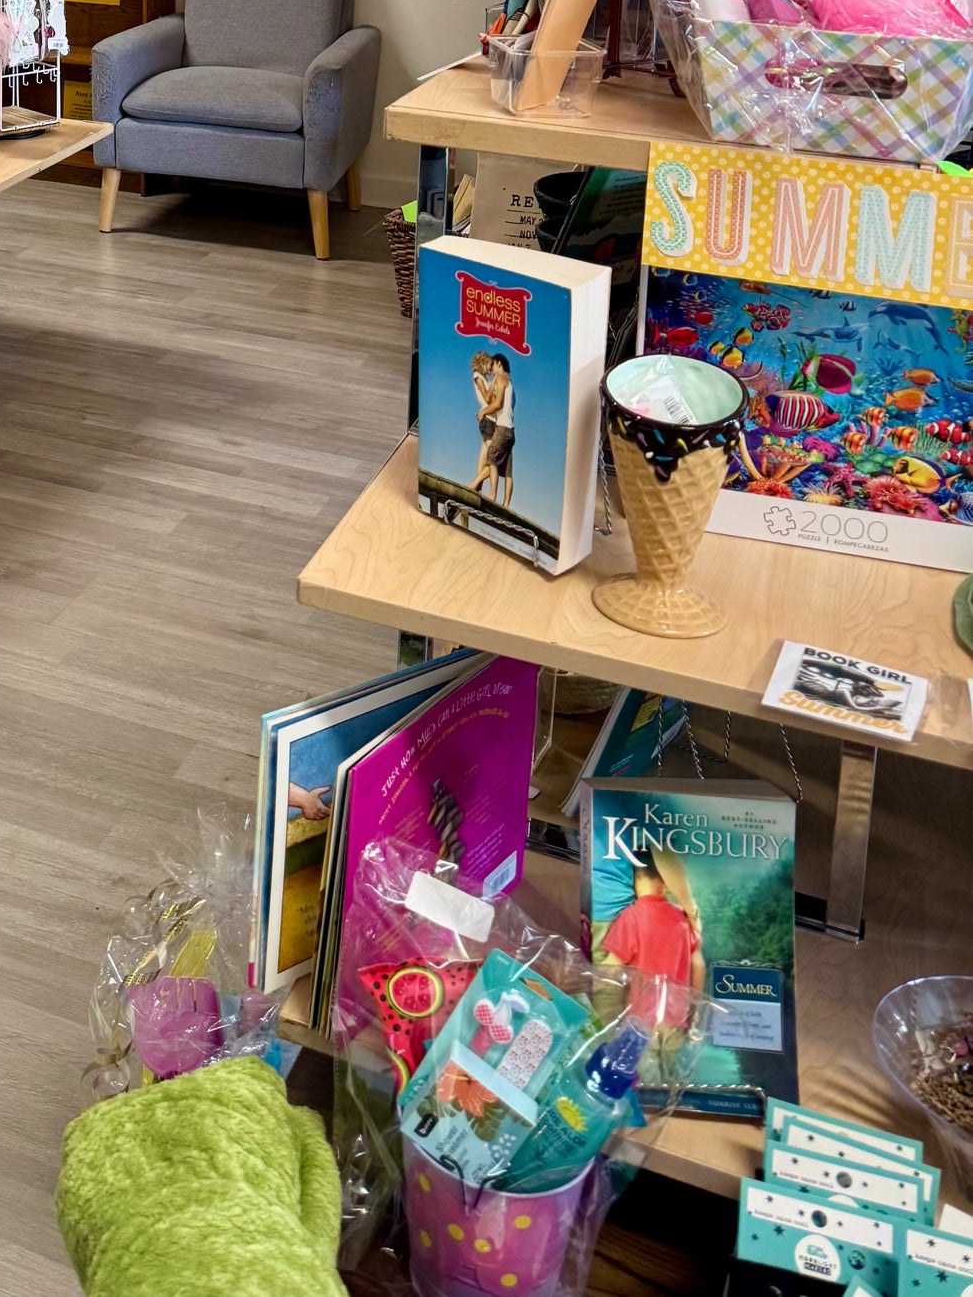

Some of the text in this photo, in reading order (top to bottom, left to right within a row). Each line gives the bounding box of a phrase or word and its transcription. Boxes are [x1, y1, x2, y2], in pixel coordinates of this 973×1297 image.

[520, 216, 537, 225] MAY
[466, 287, 521, 313] endless
[466, 299, 521, 328] SUMMER
[800, 510, 888, 544] 2000
[797, 533, 889, 552] PUZZLE ROMPECABEZAS
[804, 647, 913, 685] BOOK GIRL
[778, 691, 908, 734] Summer
[644, 803, 708, 828] Karen
[721, 816, 777, 825] BEST-SELLING
[602, 816, 790, 868] KINGSBURY
[715, 974, 778, 997] SUMMER
